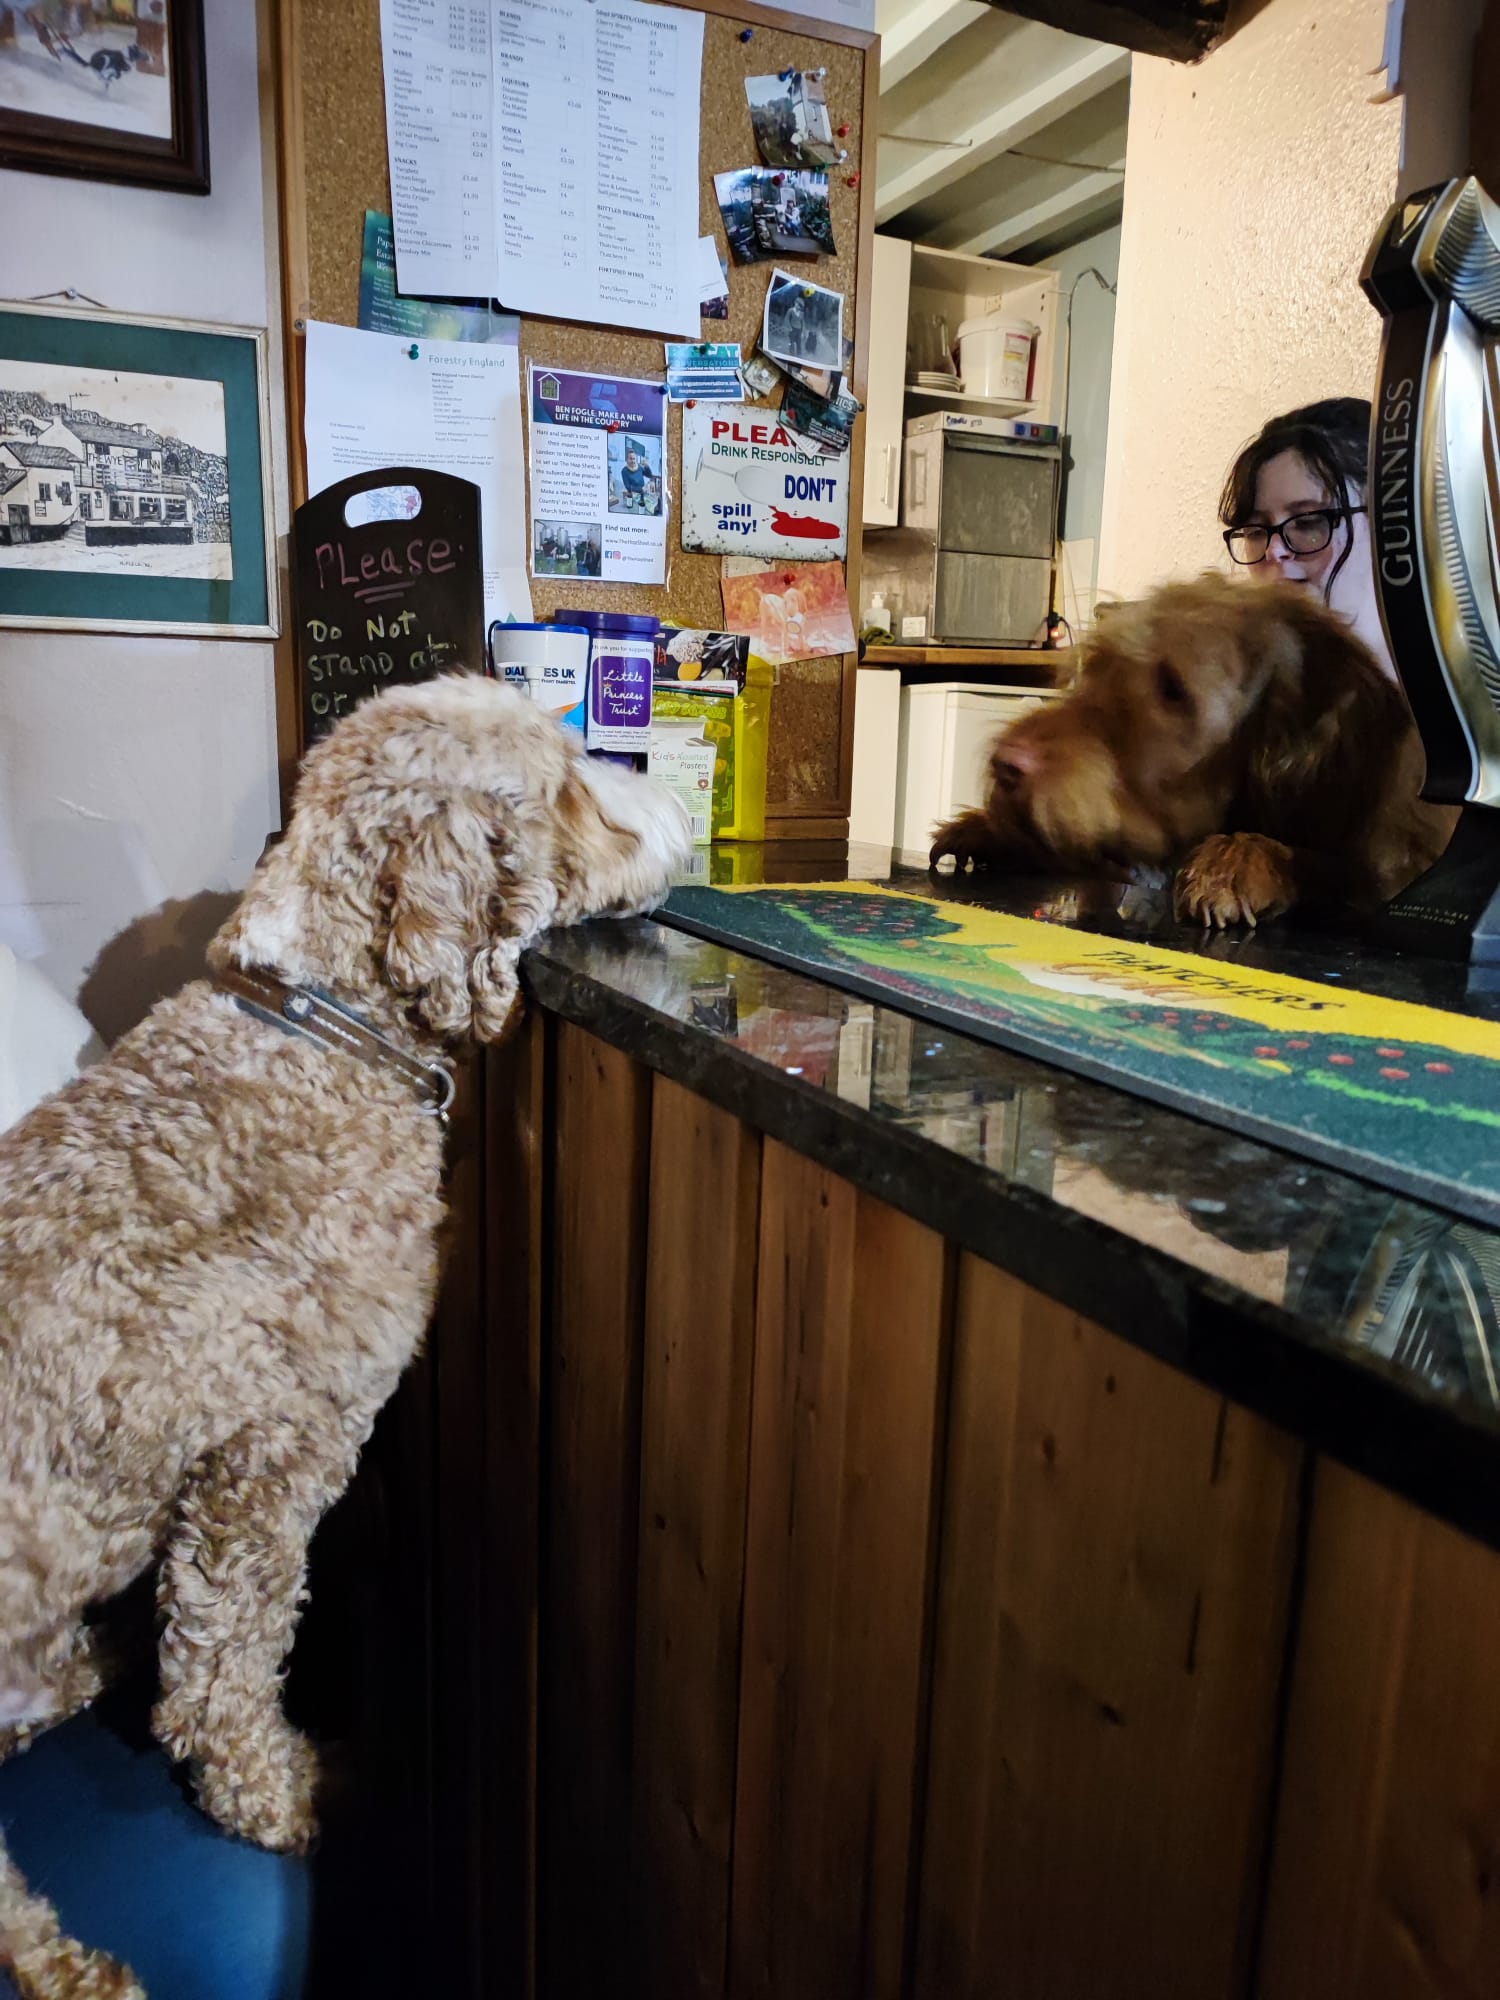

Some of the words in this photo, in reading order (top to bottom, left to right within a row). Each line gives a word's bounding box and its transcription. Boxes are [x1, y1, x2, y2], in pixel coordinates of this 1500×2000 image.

[394, 156, 417, 166] SNACKS
[501, 160, 513, 169] GIN
[428, 354, 467, 367] Forestry
[469, 356, 505, 369] England
[555, 405, 571, 414] BEN
[598, 410, 619, 419] MAKE
[627, 413, 644, 423] NEW
[555, 413, 571, 421] LIFE
[571, 414, 579, 422] IN
[580, 415, 594, 424] THE
[712, 420, 797, 449] PLEA
[711, 442, 748, 459] DRINK
[784, 474, 837, 503] DON'T
[1381, 377, 1414, 587] GUINNESS
[712, 503, 752, 518] spill
[717, 519, 757, 536] any!
[504, 666, 560, 678] DIAES
[561, 668, 576, 679] UK
[603, 669, 645, 683] Little
[603, 688, 645, 702] Princess
[609, 702, 640, 716] Trust
[652, 751, 676, 761] Kids
[680, 761, 708, 770] Plasters
[1083, 949, 1346, 1012] THATCHERS
